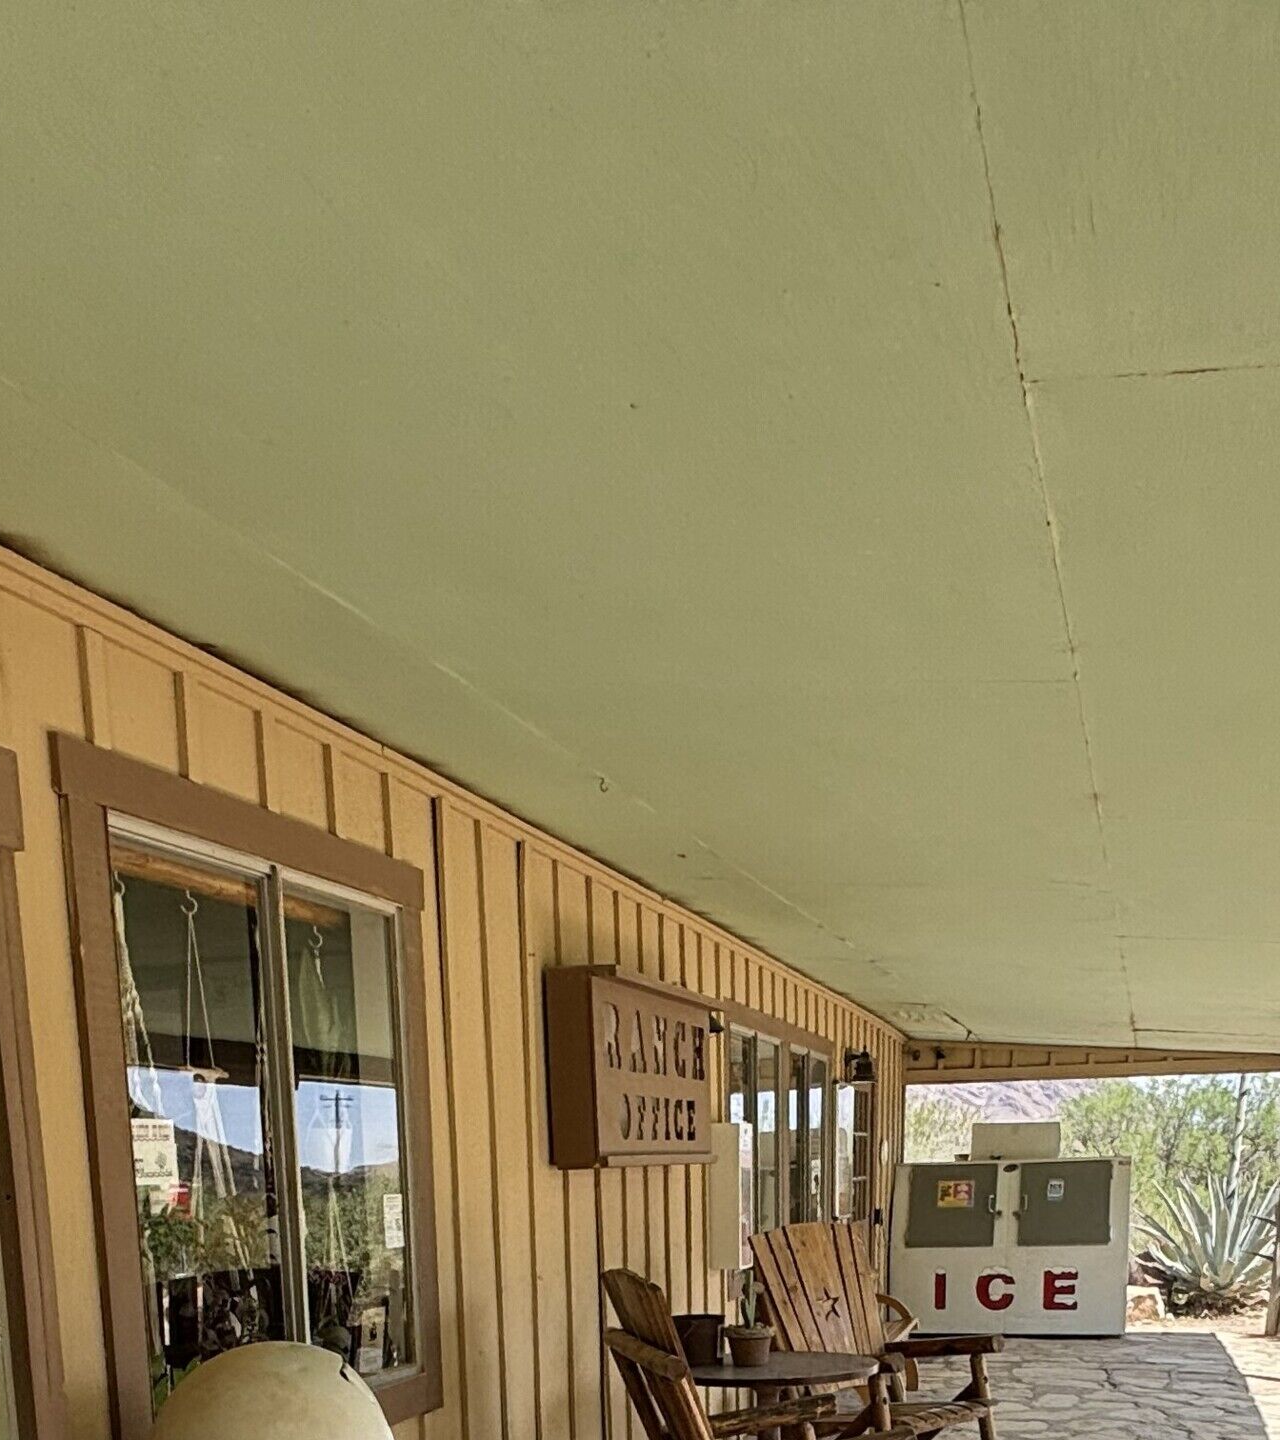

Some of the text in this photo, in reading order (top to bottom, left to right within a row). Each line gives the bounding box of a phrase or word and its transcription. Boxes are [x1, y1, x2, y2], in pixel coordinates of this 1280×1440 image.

[603, 1001, 706, 1081] RANCH
[619, 1092, 696, 1141] OFFICE
[934, 1265, 1078, 1311] ICE
